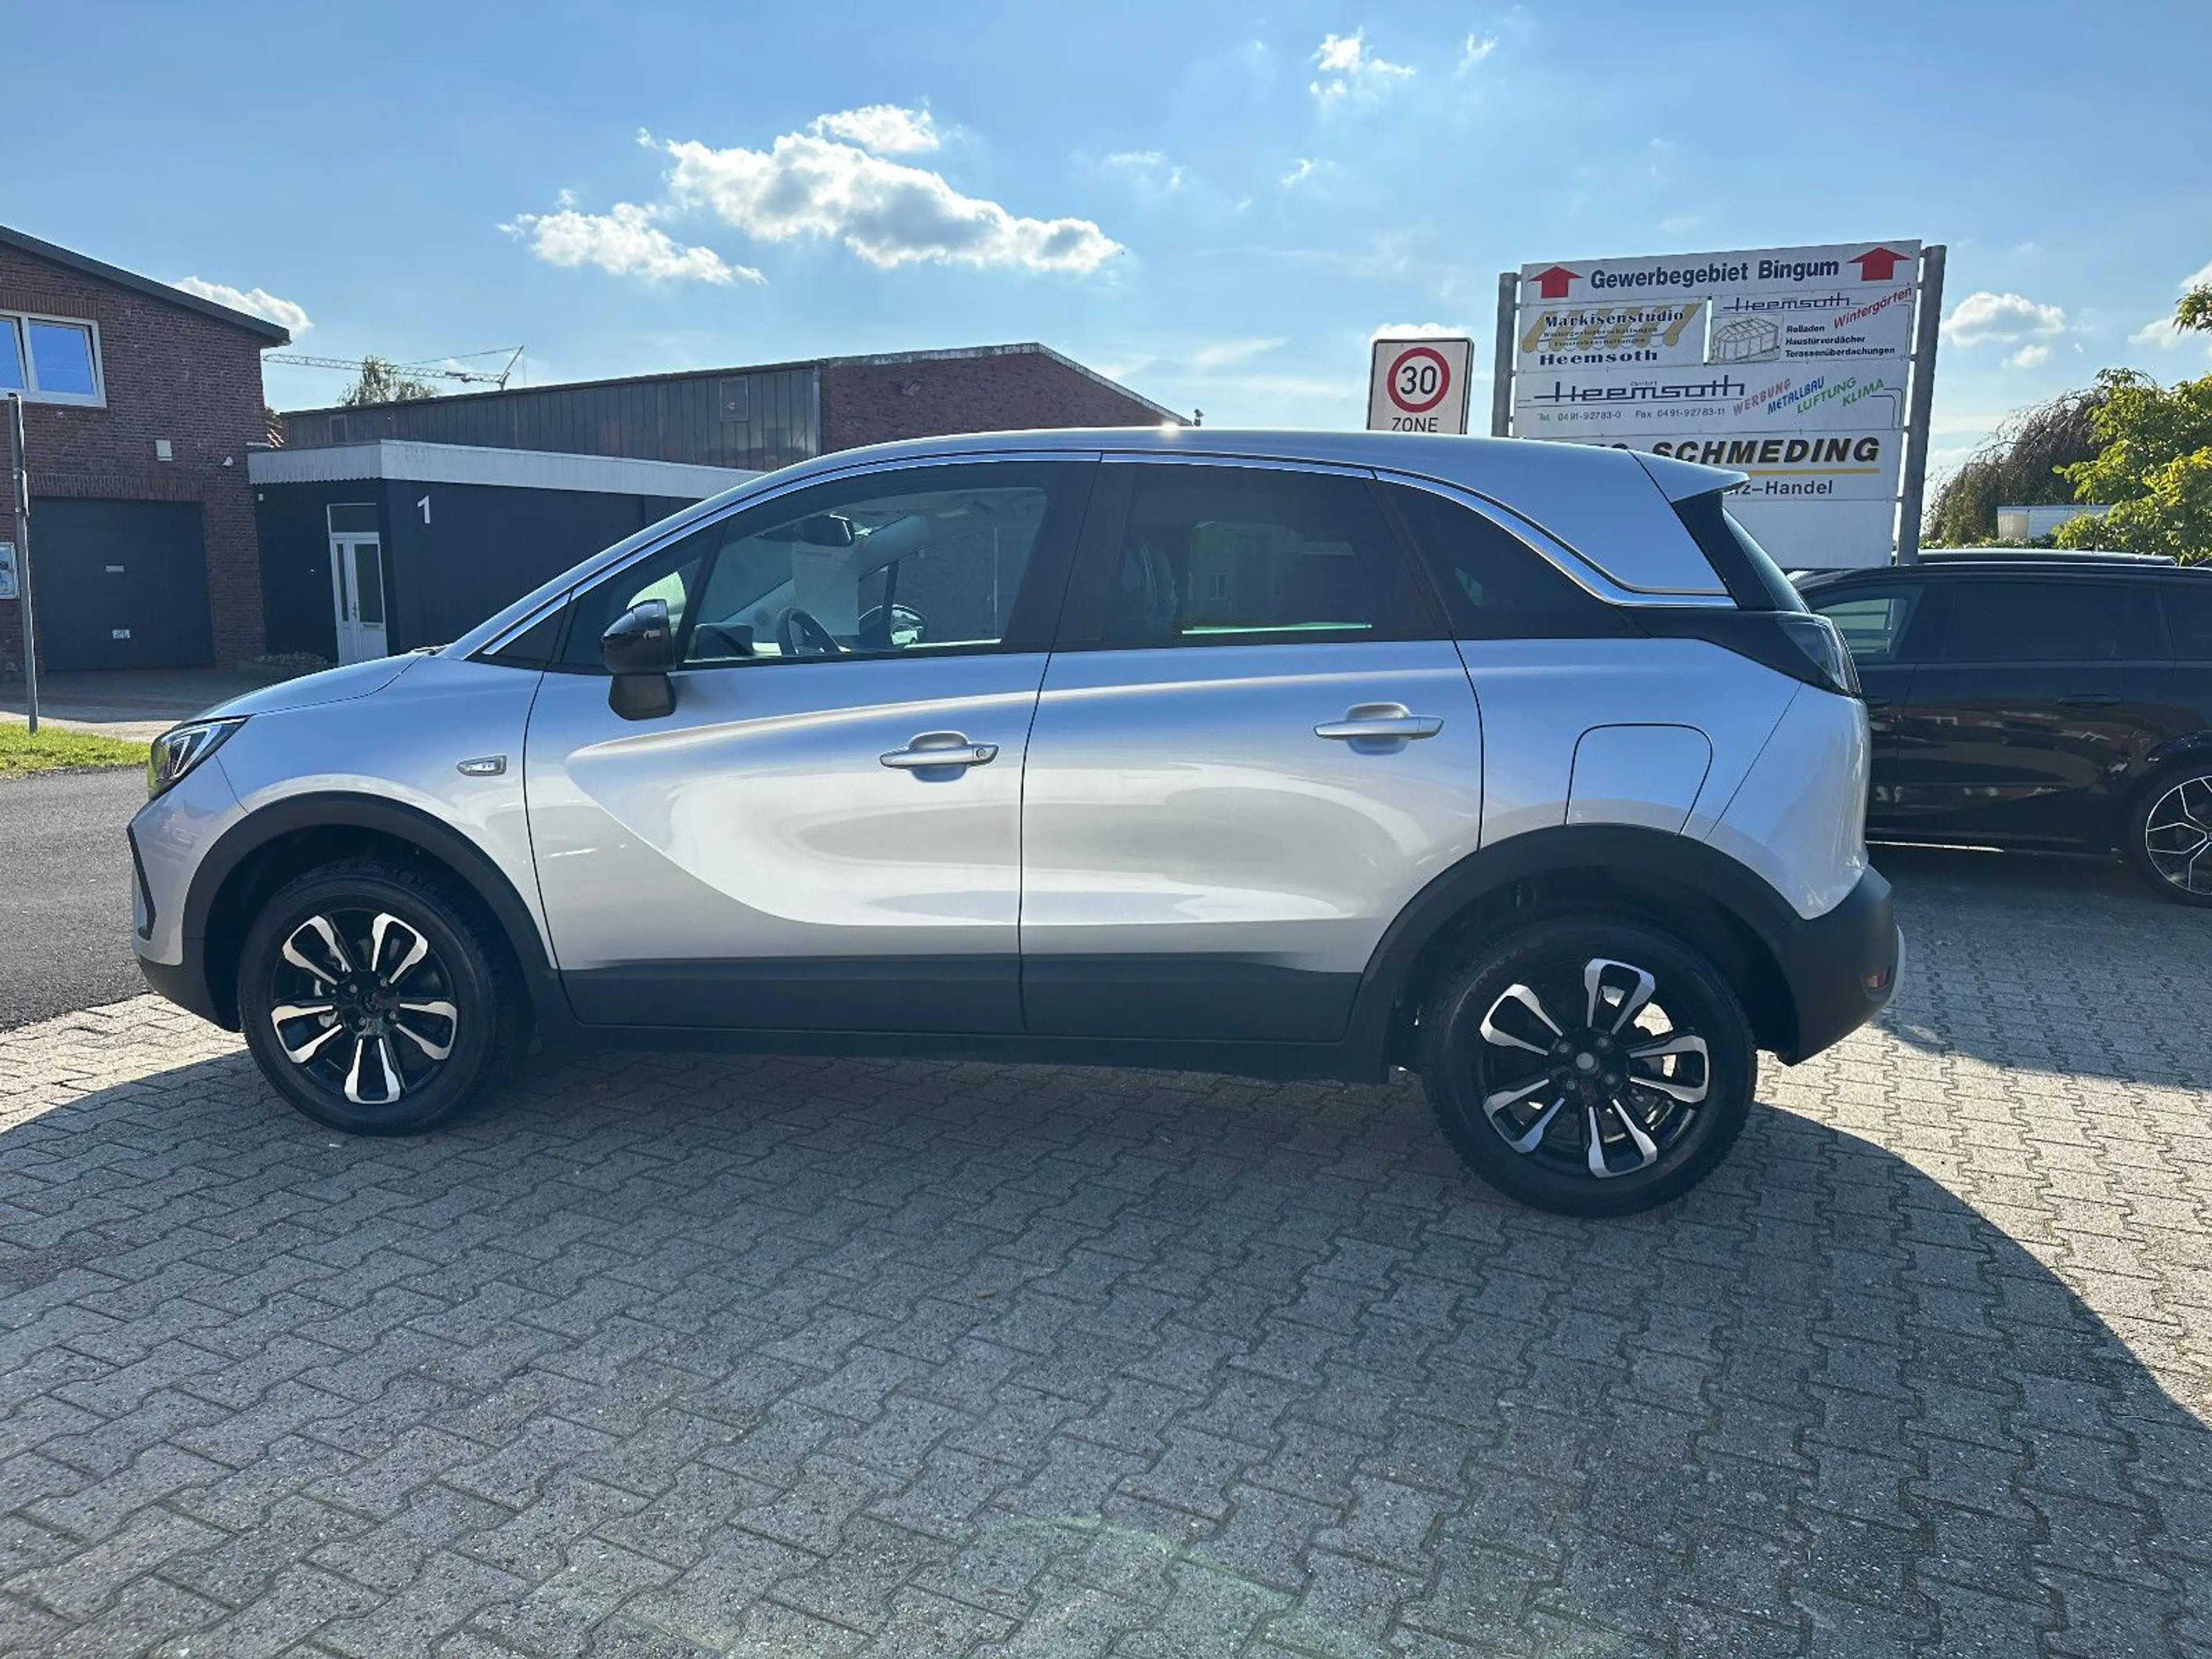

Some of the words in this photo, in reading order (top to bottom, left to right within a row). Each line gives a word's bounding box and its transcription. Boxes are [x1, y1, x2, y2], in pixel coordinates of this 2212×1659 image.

[1590, 262, 1748, 288] Gewerbegebiet
[1758, 260, 1839, 281] Bingum
[1723, 291, 1850, 312] Heemsoth
[1834, 287, 1912, 328] Wintergärten
[1544, 309, 1684, 327] Markisenstudio
[1786, 324, 1825, 333] Rolladen
[1540, 350, 1658, 365] Heemsoth
[1400, 366, 1437, 395] 30
[1534, 374, 1745, 402] Heemsoth
[1842, 378, 1884, 407] KLIMA
[1733, 378, 1791, 416] WERBUNG
[1767, 376, 1825, 415] METALLBAU
[1392, 417, 1438, 432] ZONE
[1635, 410, 1652, 418] Fax
[1652, 436, 1881, 465] SCHMEDING
[418, 495, 430, 524] 1
